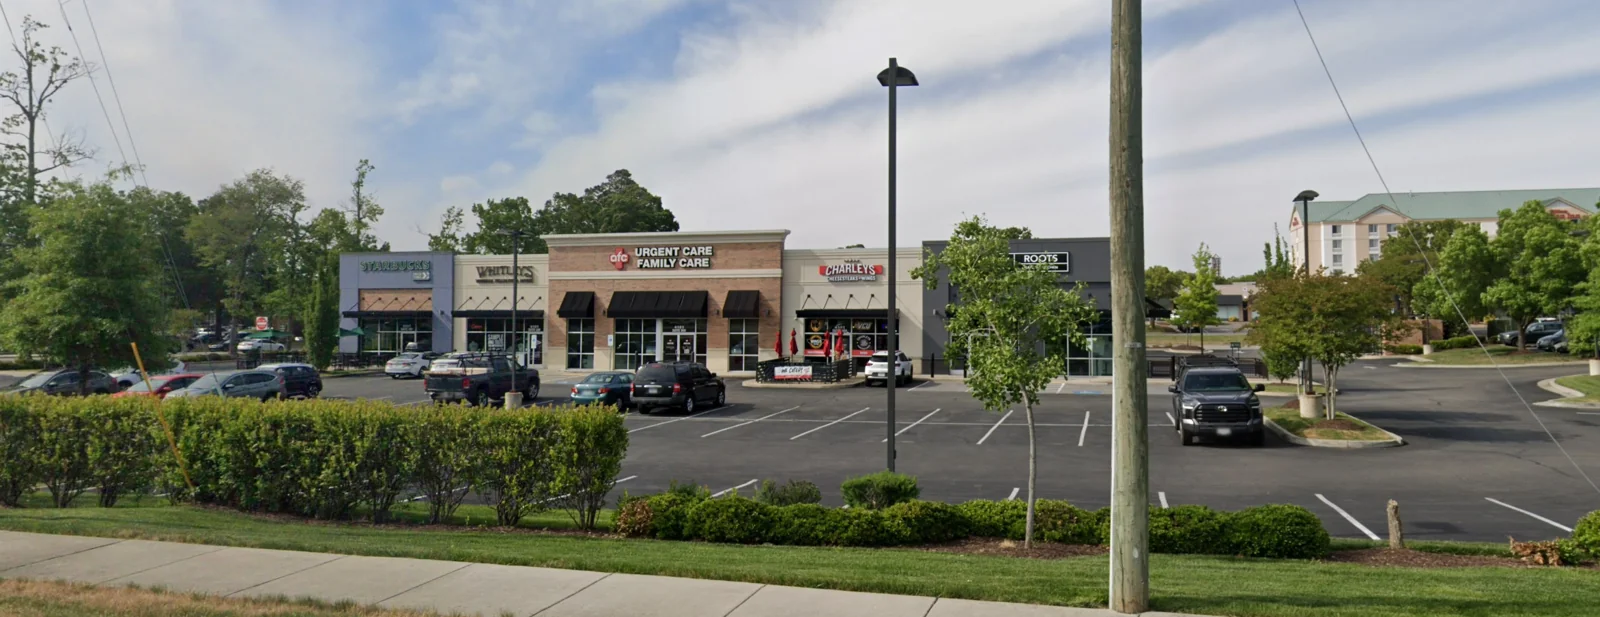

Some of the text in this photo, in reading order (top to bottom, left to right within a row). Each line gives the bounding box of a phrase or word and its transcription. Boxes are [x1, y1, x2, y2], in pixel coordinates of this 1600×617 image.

[610, 251, 628, 262] afc
[635, 246, 713, 257] URGENT CARE
[637, 258, 709, 268] FAMILY CARE
[1024, 254, 1058, 263] ROOTS
[360, 261, 430, 271] STARBUCKS
[825, 263, 876, 276] CHARLEYS
